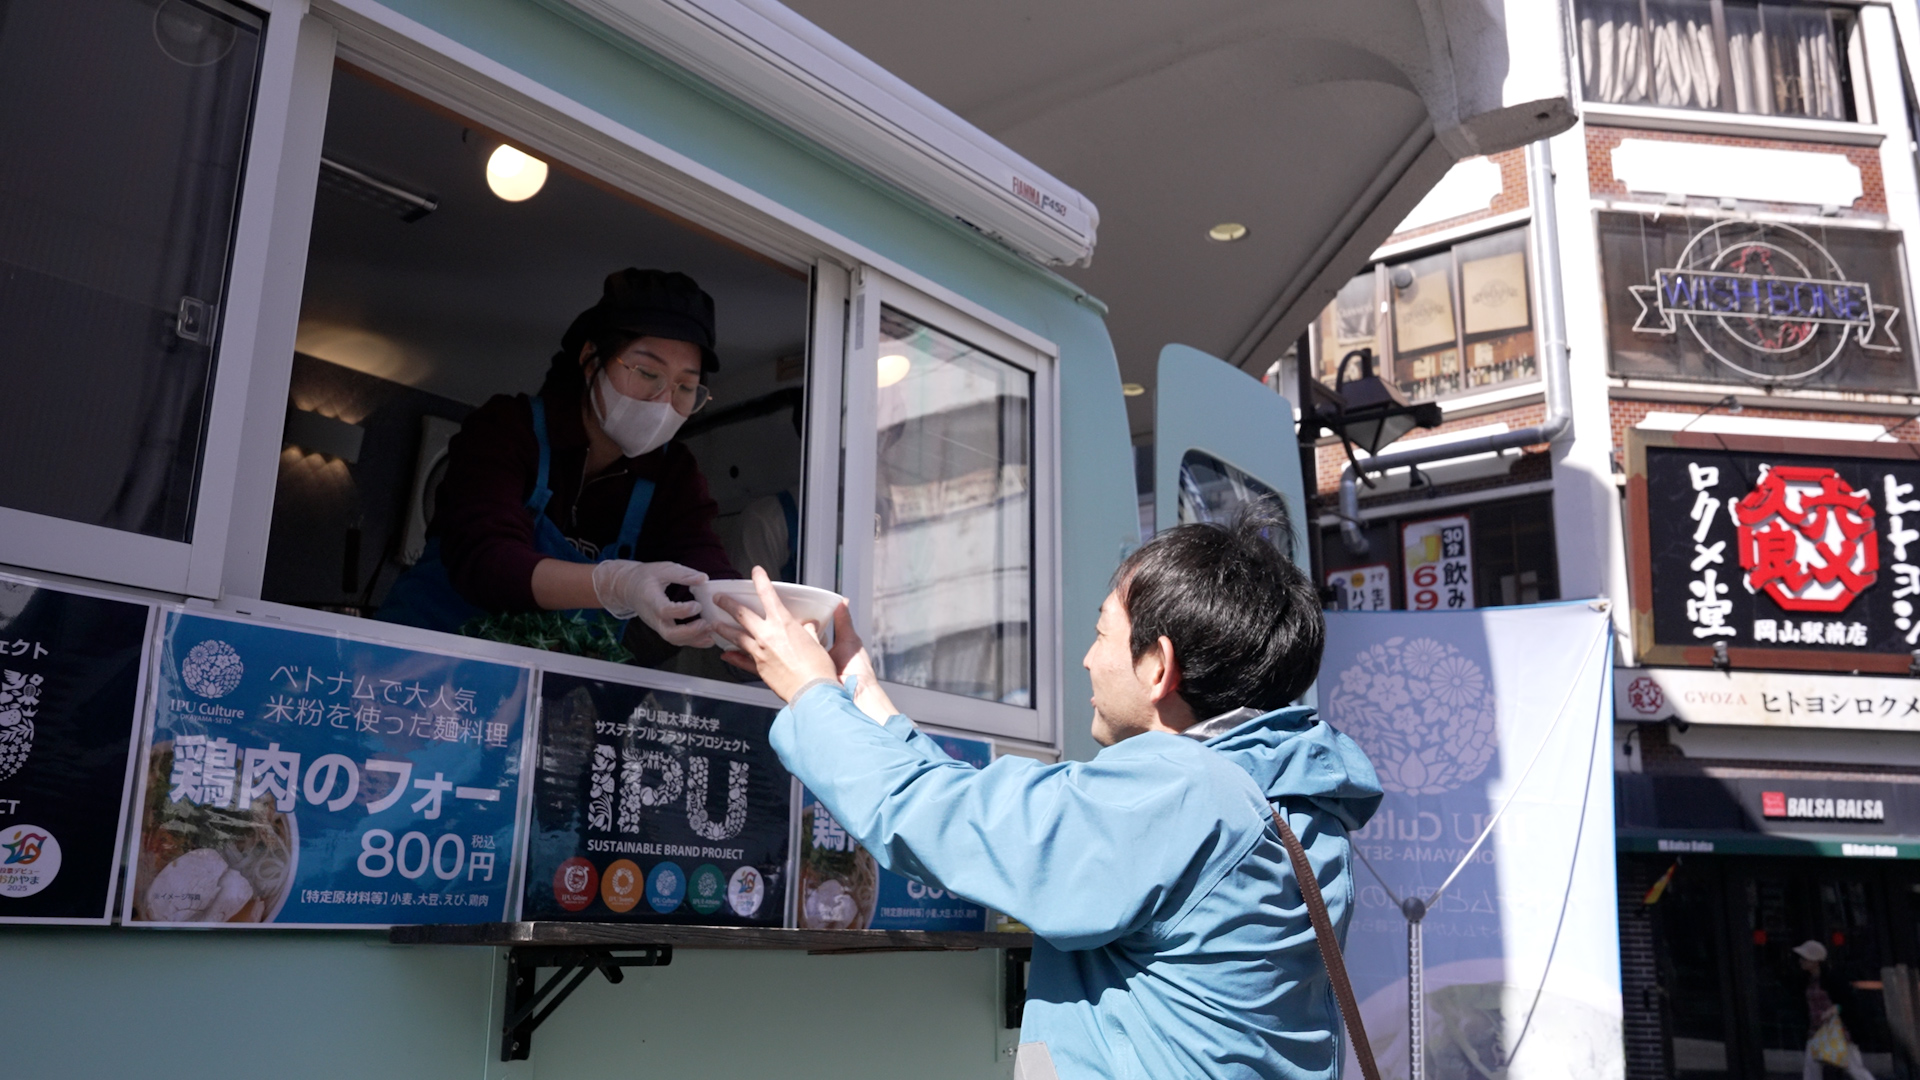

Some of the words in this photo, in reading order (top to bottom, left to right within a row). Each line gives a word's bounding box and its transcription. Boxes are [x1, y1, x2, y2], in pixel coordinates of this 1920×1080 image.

[1686, 462, 1737, 638] ロクメ堂
[1753, 619, 1868, 646] 岡山駅前店
[269, 665, 477, 715] ベトナムで大人気
[1684, 690, 1748, 706] GYOZA
[170, 699, 197, 713] IPU
[198, 703, 245, 719] Culture
[263, 694, 509, 748] 米粉を使った麺料理
[595, 720, 750, 753] サステナブルブランドプロジェクト
[168, 735, 501, 820] 鶏肉のフォー
[588, 743, 750, 841] IPU
[1787, 797, 1835, 817] BALSA
[1836, 798, 1884, 819] BALSA
[471, 834, 496, 849] 税込
[812, 801, 861, 853] 鶏
[587, 839, 662, 856] SUSTAINABLE
[664, 846, 700, 857] BRAND
[702, 849, 744, 860] PROJECT
